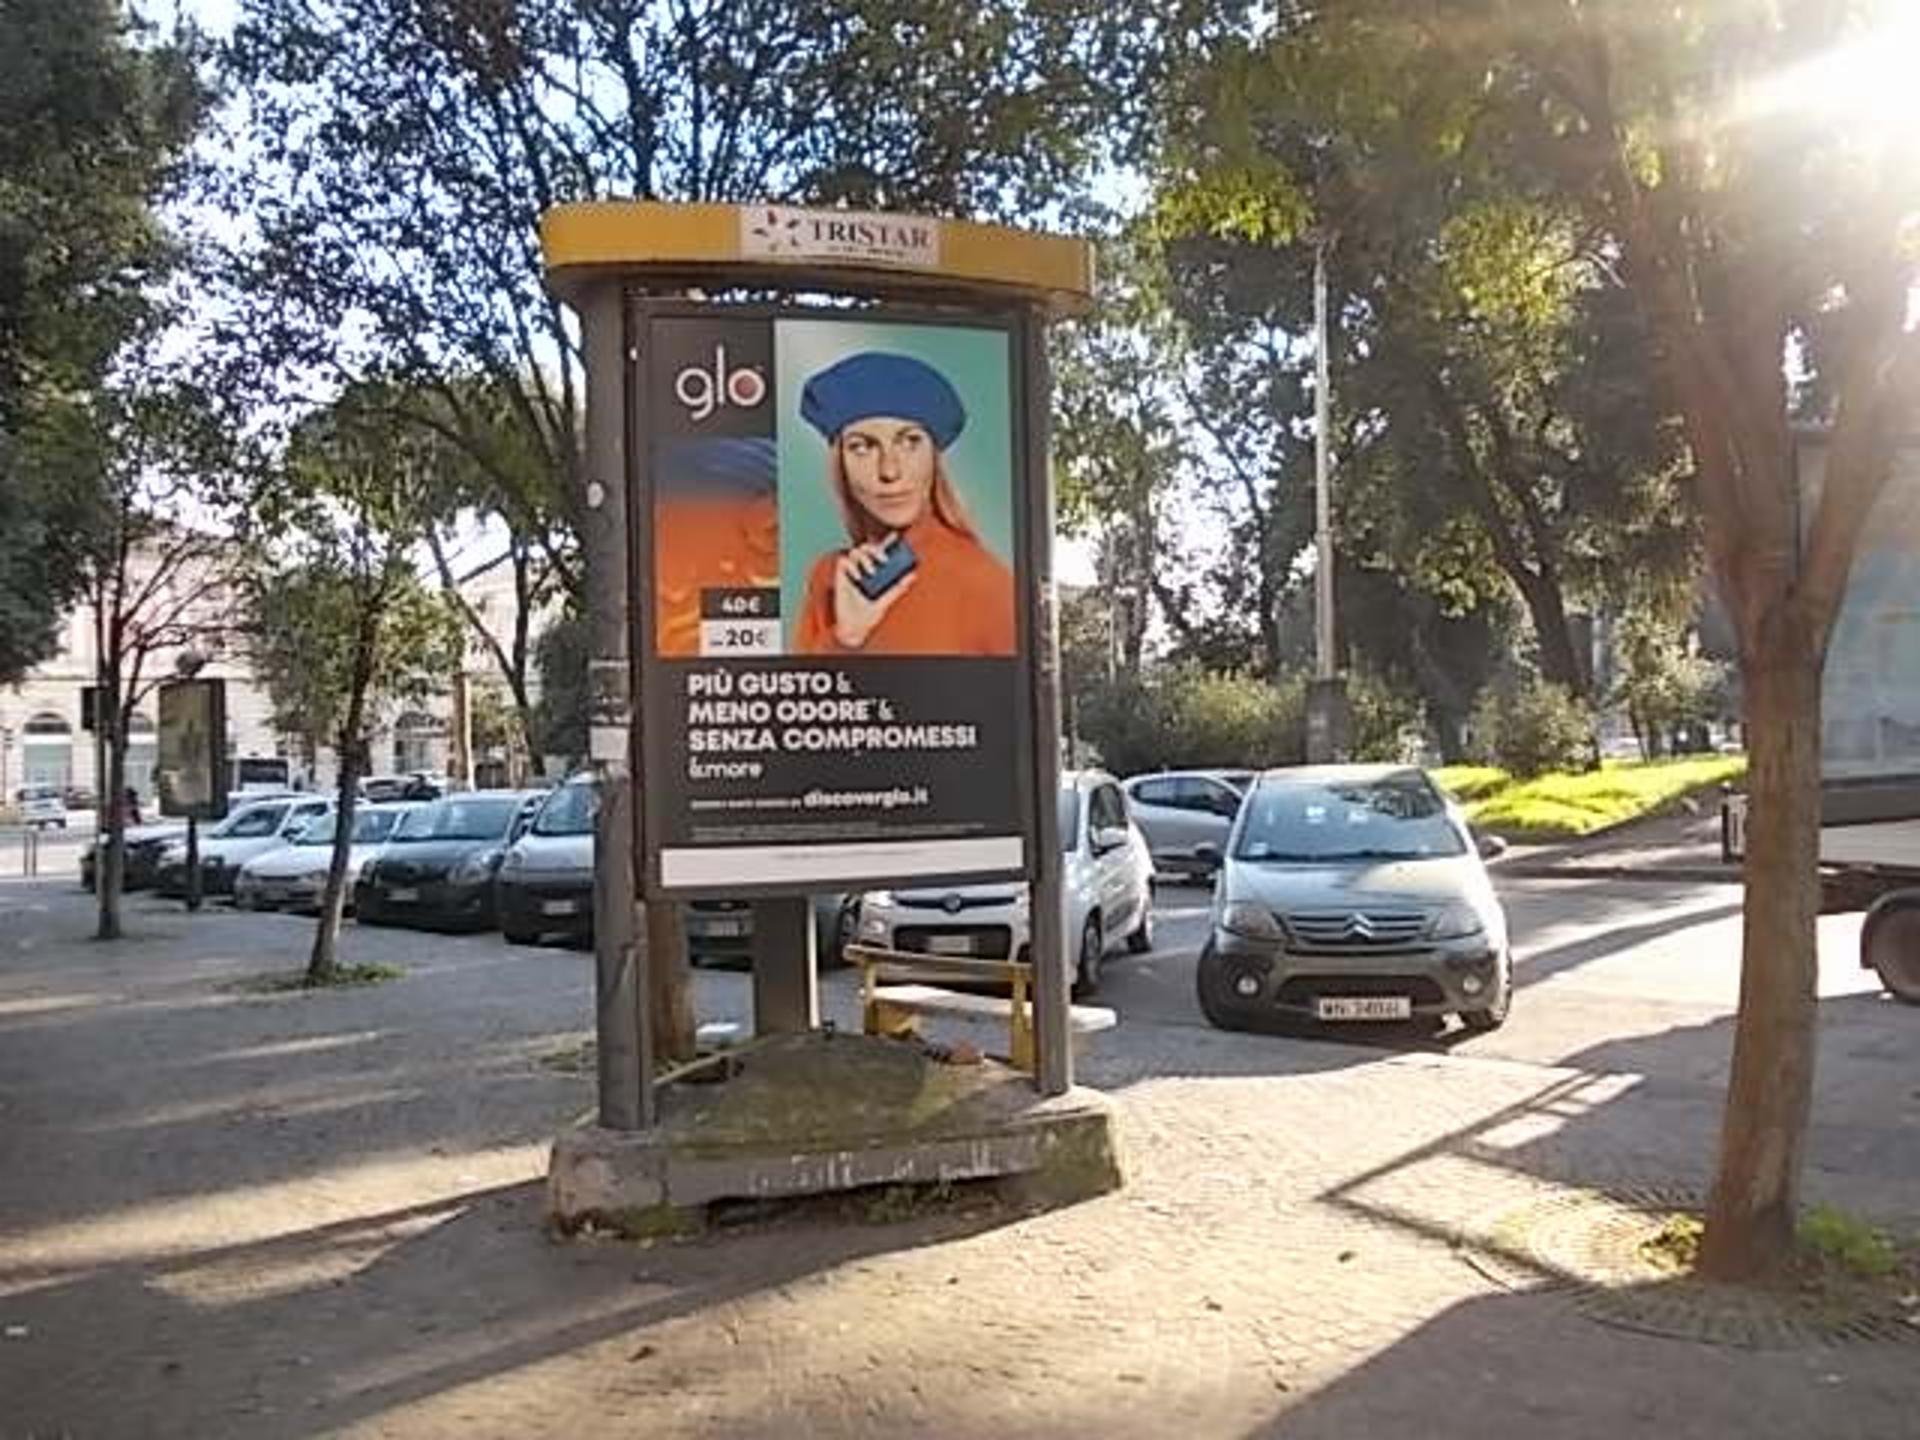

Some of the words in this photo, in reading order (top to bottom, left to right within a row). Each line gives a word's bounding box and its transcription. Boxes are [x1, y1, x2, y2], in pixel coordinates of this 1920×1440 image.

[808, 219, 929, 248] TRISTAR
[676, 344, 765, 420] glo
[688, 668, 733, 696] PIÙ
[738, 671, 832, 695] GUSTO
[688, 700, 771, 723] MENO
[689, 729, 776, 751] SENZA
[783, 725, 977, 750] COMPROMESSI
